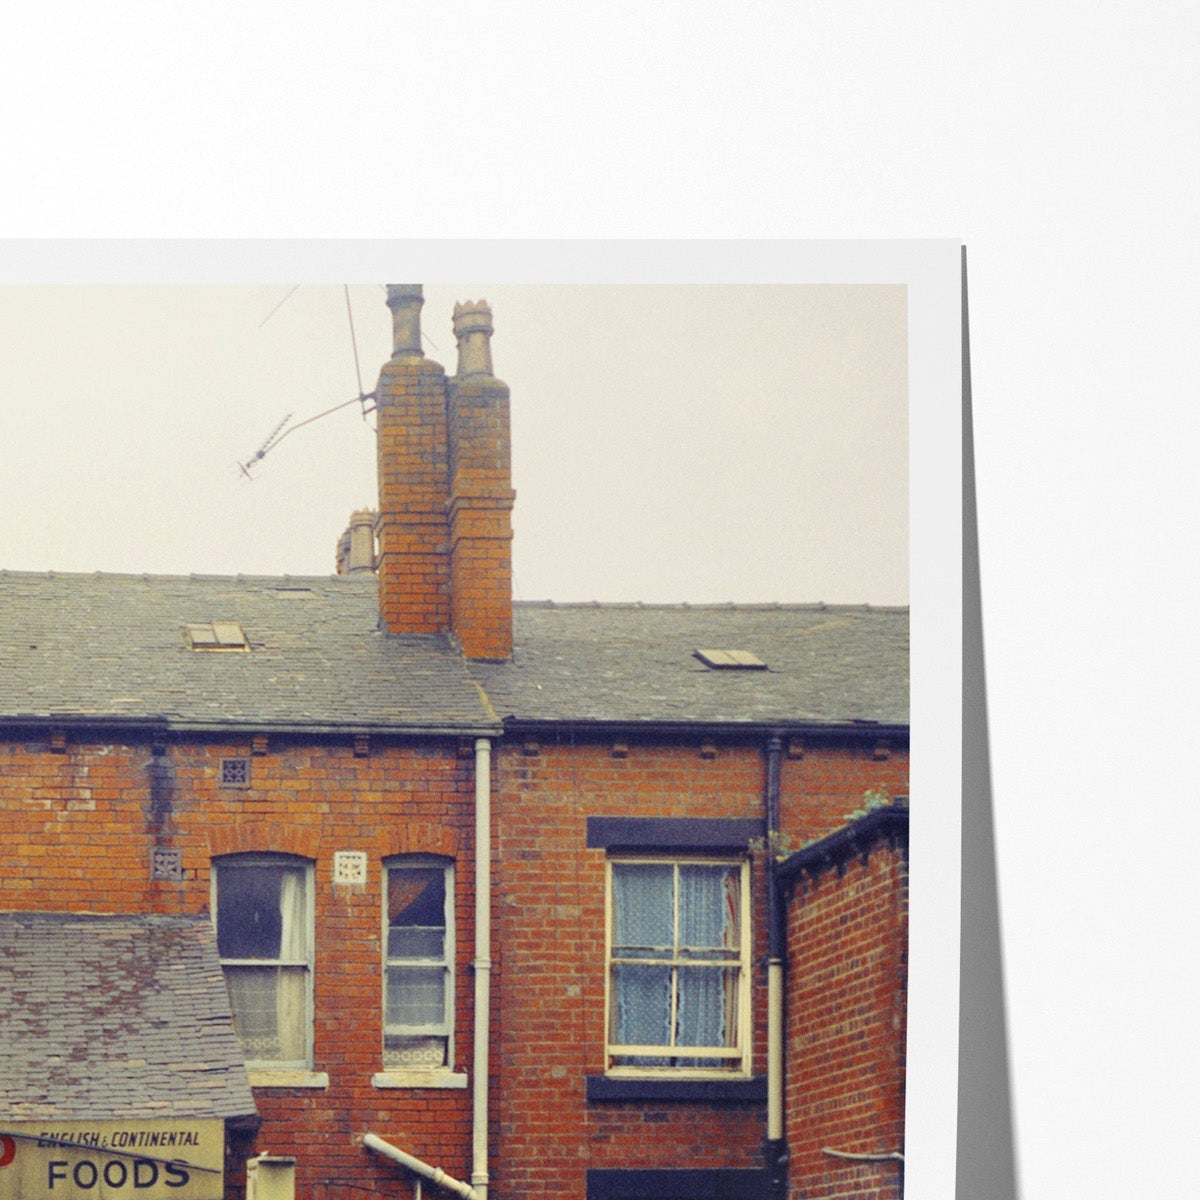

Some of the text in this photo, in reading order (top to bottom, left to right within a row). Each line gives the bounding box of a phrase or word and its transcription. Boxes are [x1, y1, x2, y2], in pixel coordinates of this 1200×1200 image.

[38, 1131, 99, 1148] ENGLISH
[111, 1131, 200, 1147] CONTINENTAL
[48, 1159, 190, 1189] FOODS
